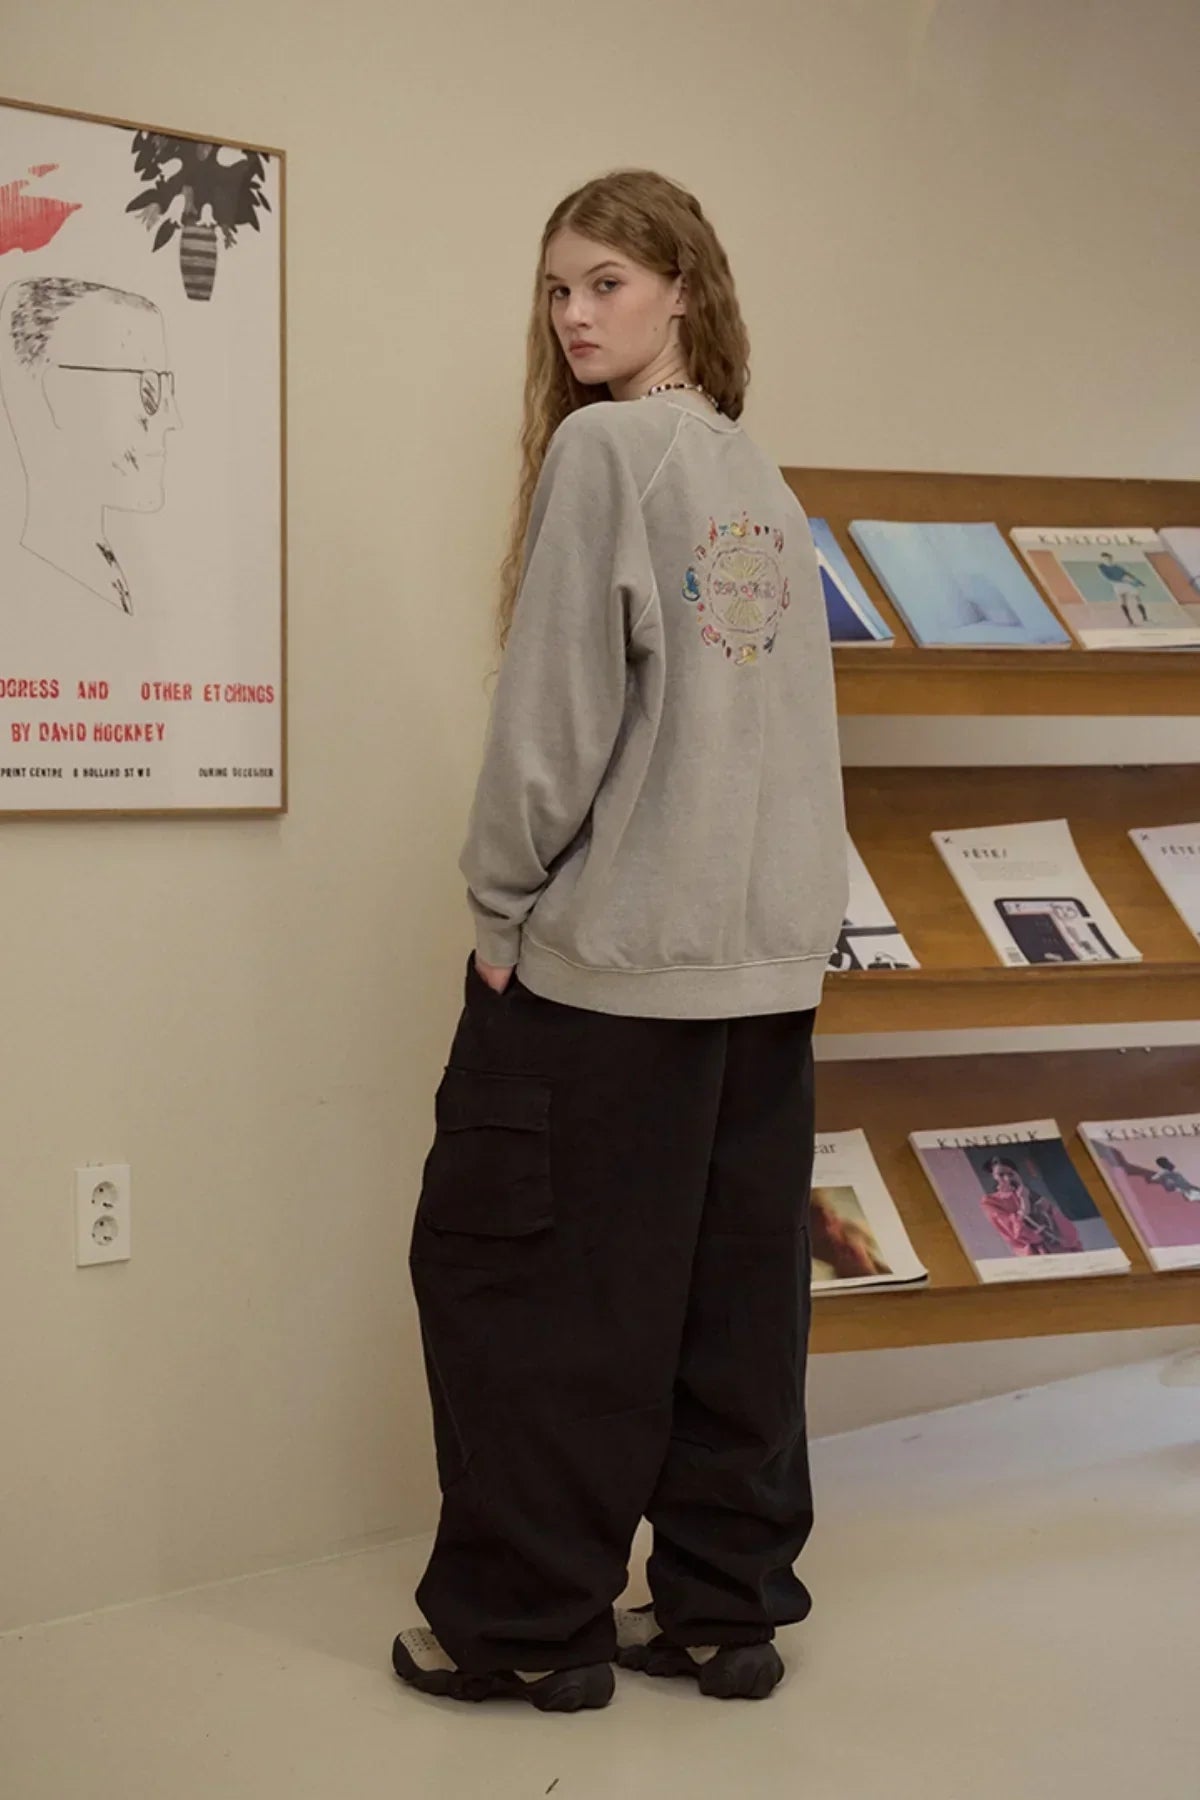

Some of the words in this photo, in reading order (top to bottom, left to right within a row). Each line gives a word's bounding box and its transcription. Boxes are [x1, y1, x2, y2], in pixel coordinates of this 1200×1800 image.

[78, 681, 108, 699] AND
[141, 682, 192, 701] OTHER
[11, 723, 30, 742] BY
[39, 722, 86, 742] DAVID
[93, 722, 165, 742] HOCKNEY
[0, 768, 26, 778] PRINT
[29, 768, 62, 778] CENTRE
[937, 1130, 1039, 1149] KINFOLK
